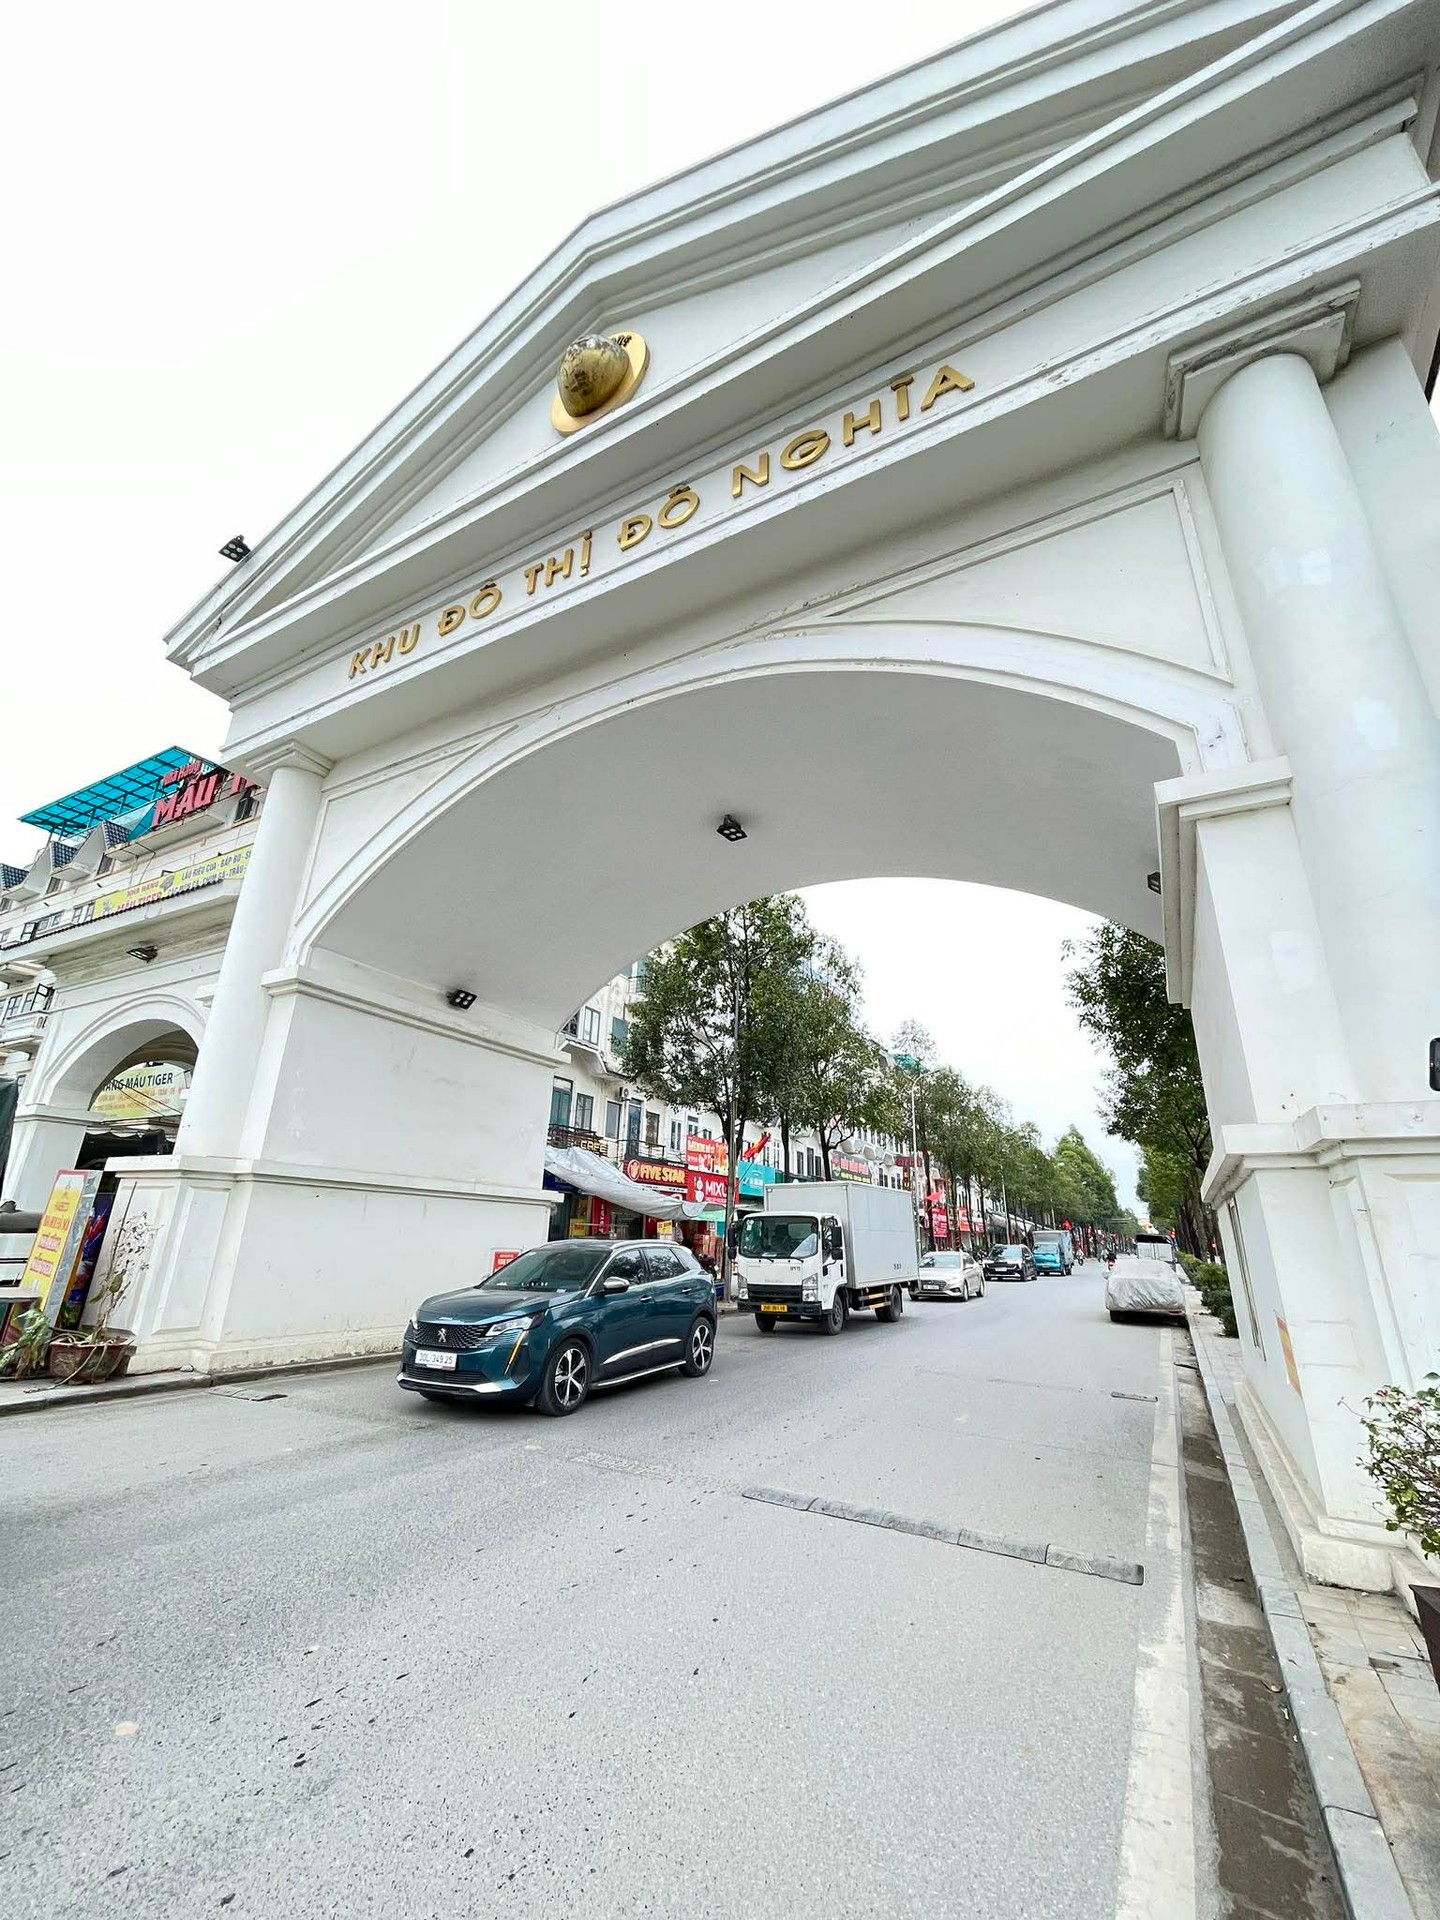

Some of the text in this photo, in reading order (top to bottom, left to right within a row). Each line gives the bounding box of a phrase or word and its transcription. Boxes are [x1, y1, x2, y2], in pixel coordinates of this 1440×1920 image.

[348, 364, 975, 679] KHU ĐÔ THỊ ĐÔ NGHĨA
[146, 1072, 174, 1086] TIGER
[640, 1163, 685, 1184] FIVE STAR
